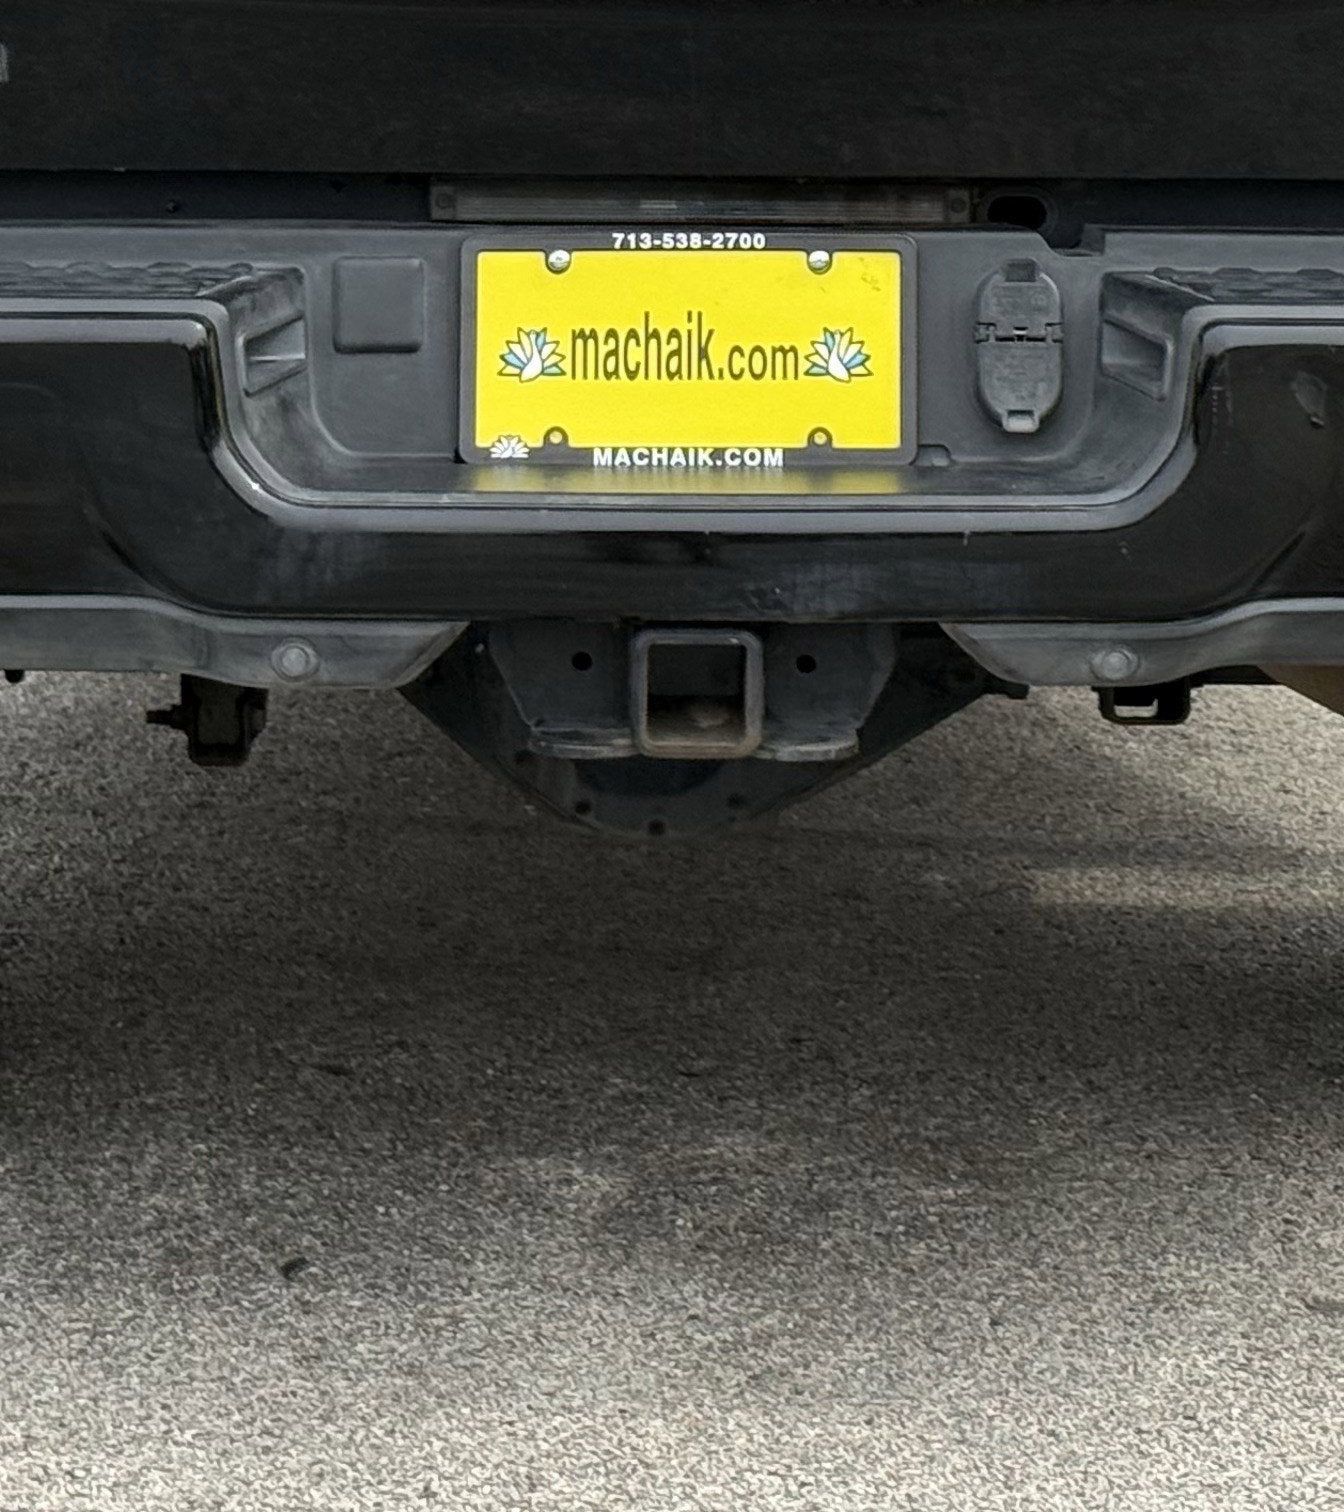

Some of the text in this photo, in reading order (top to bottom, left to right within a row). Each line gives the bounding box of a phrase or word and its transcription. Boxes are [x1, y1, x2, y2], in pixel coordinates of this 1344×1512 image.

[611, 232, 767, 250] 713-538-2700
[570, 310, 800, 382] machaik.com
[592, 447, 785, 467] MACHAIK.COM
